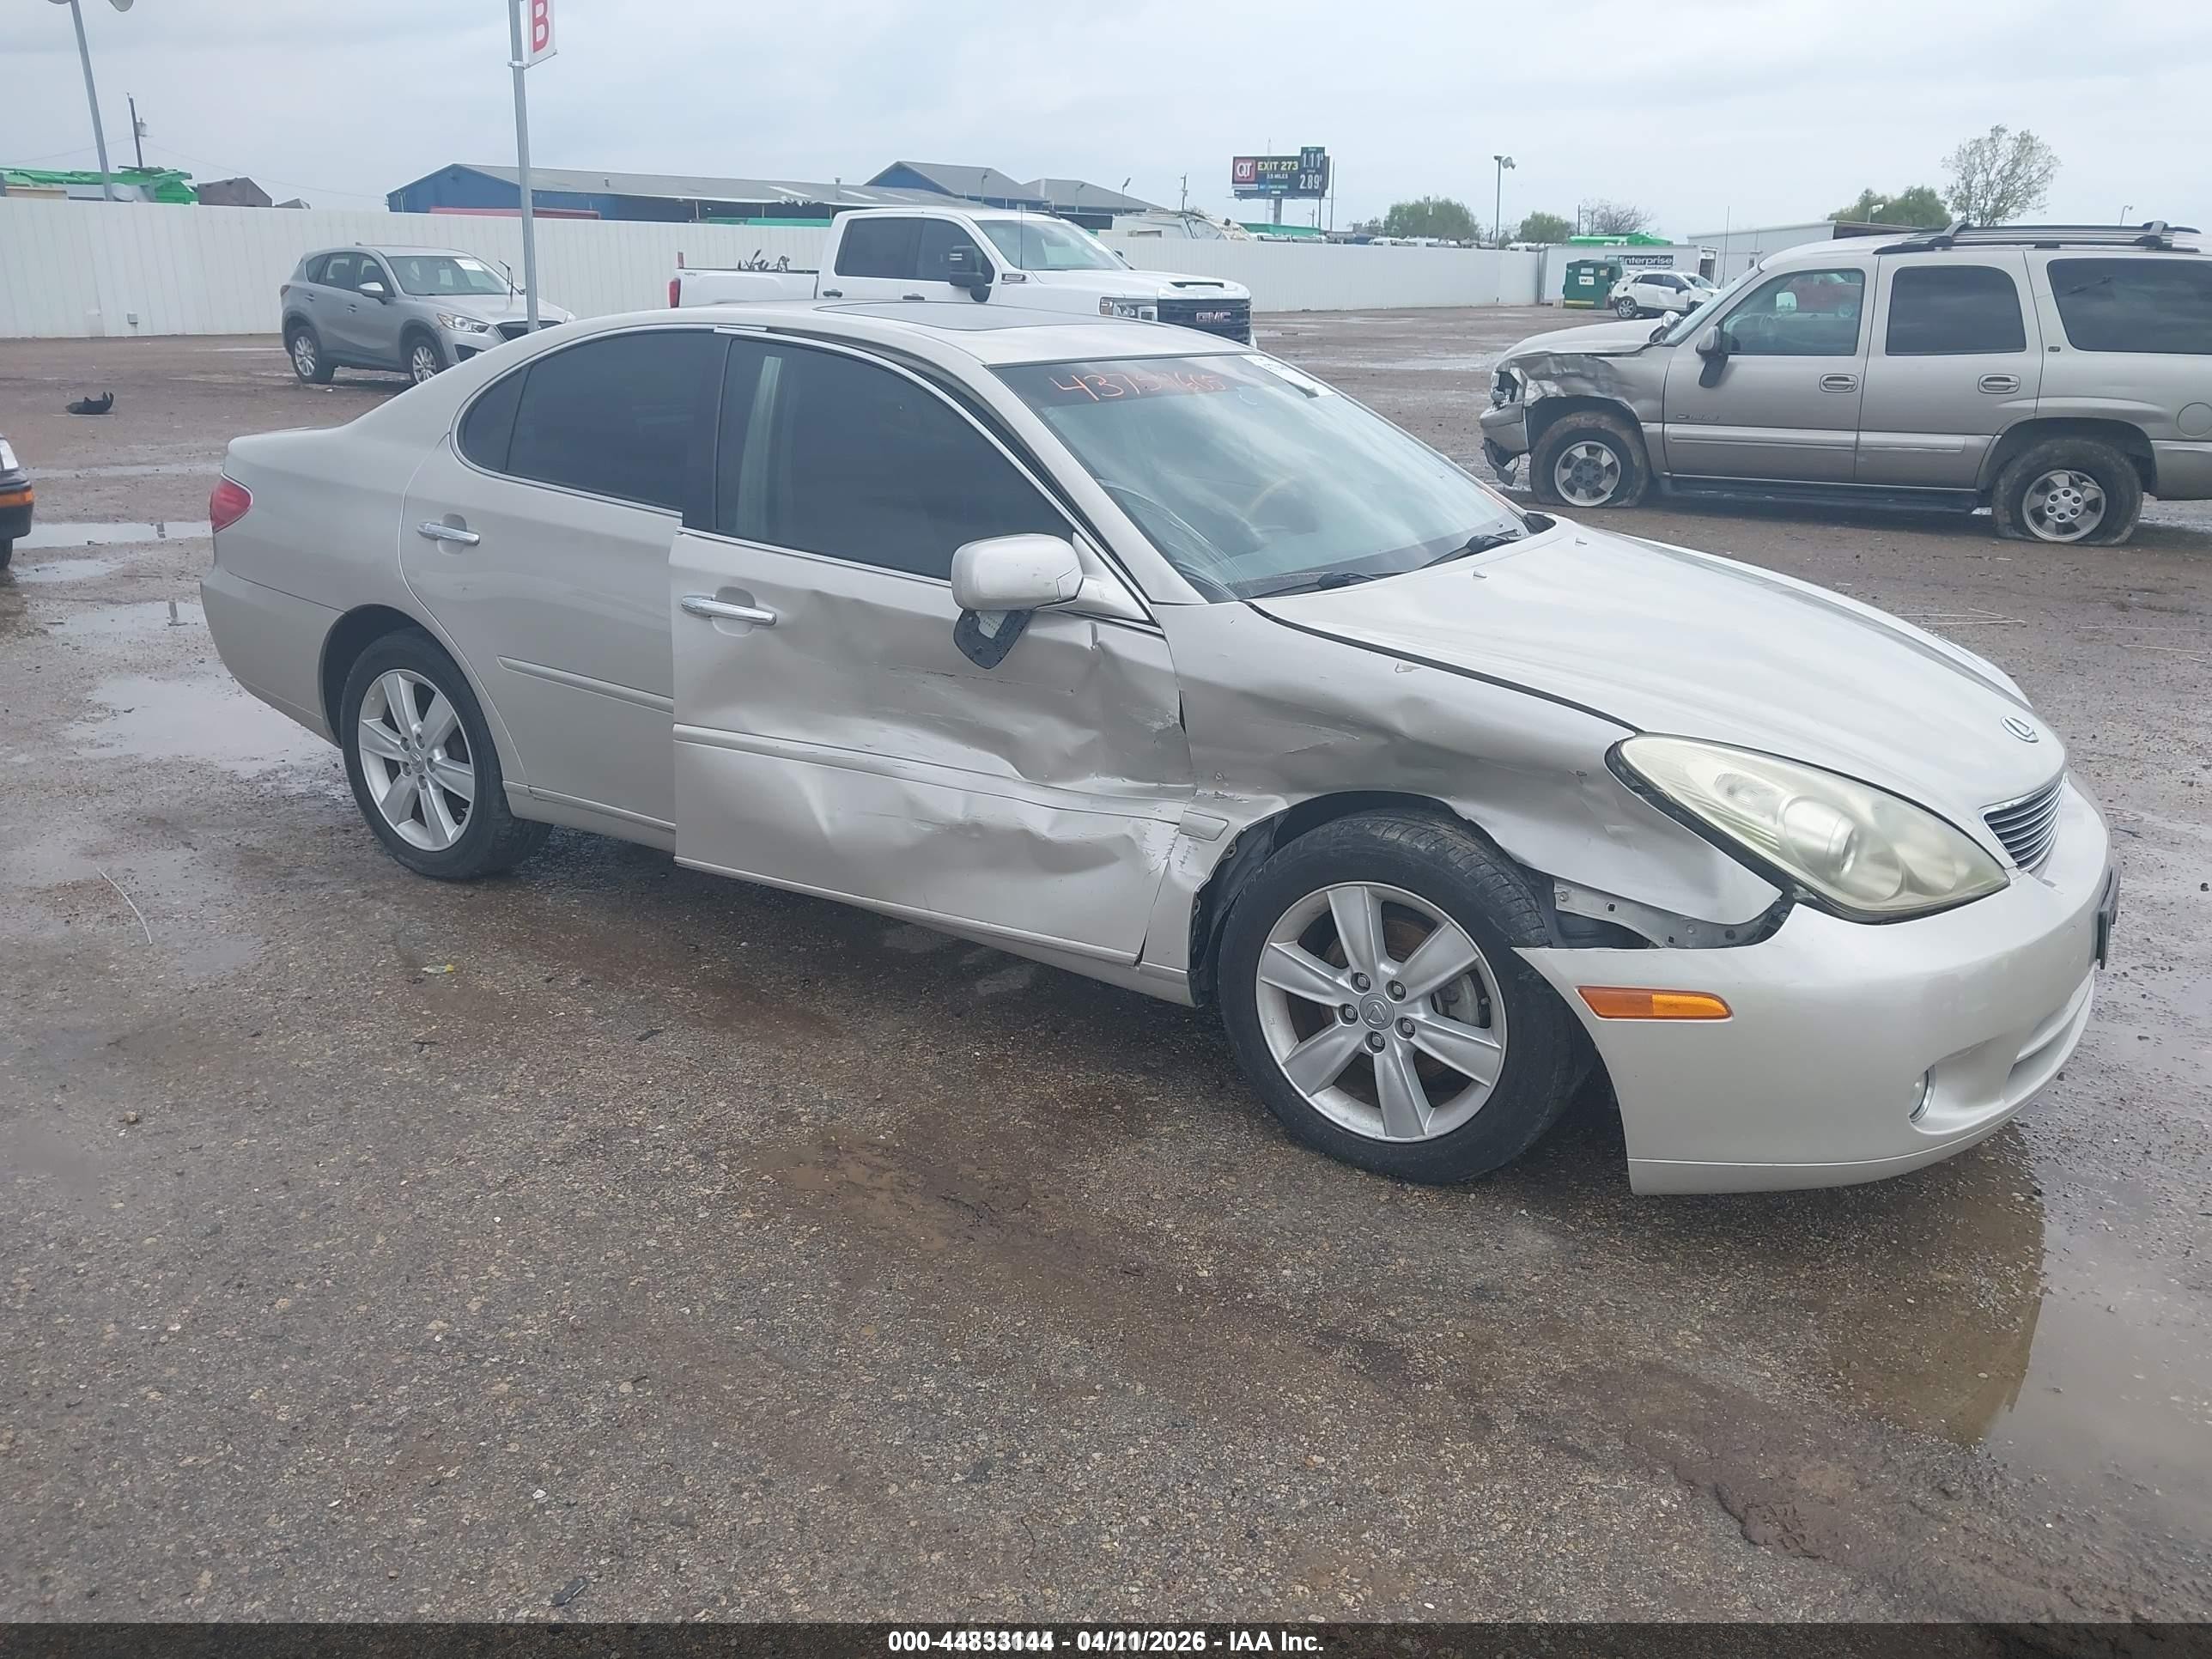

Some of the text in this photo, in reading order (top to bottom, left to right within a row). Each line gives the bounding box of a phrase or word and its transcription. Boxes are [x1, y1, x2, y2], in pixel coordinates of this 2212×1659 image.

[532, 0, 550, 53] B
[1237, 163, 1252, 178] QT
[1257, 161, 1298, 171] EXIT 273
[1619, 257, 1673, 266] Enterprise
[1196, 312, 1231, 323] GMC
